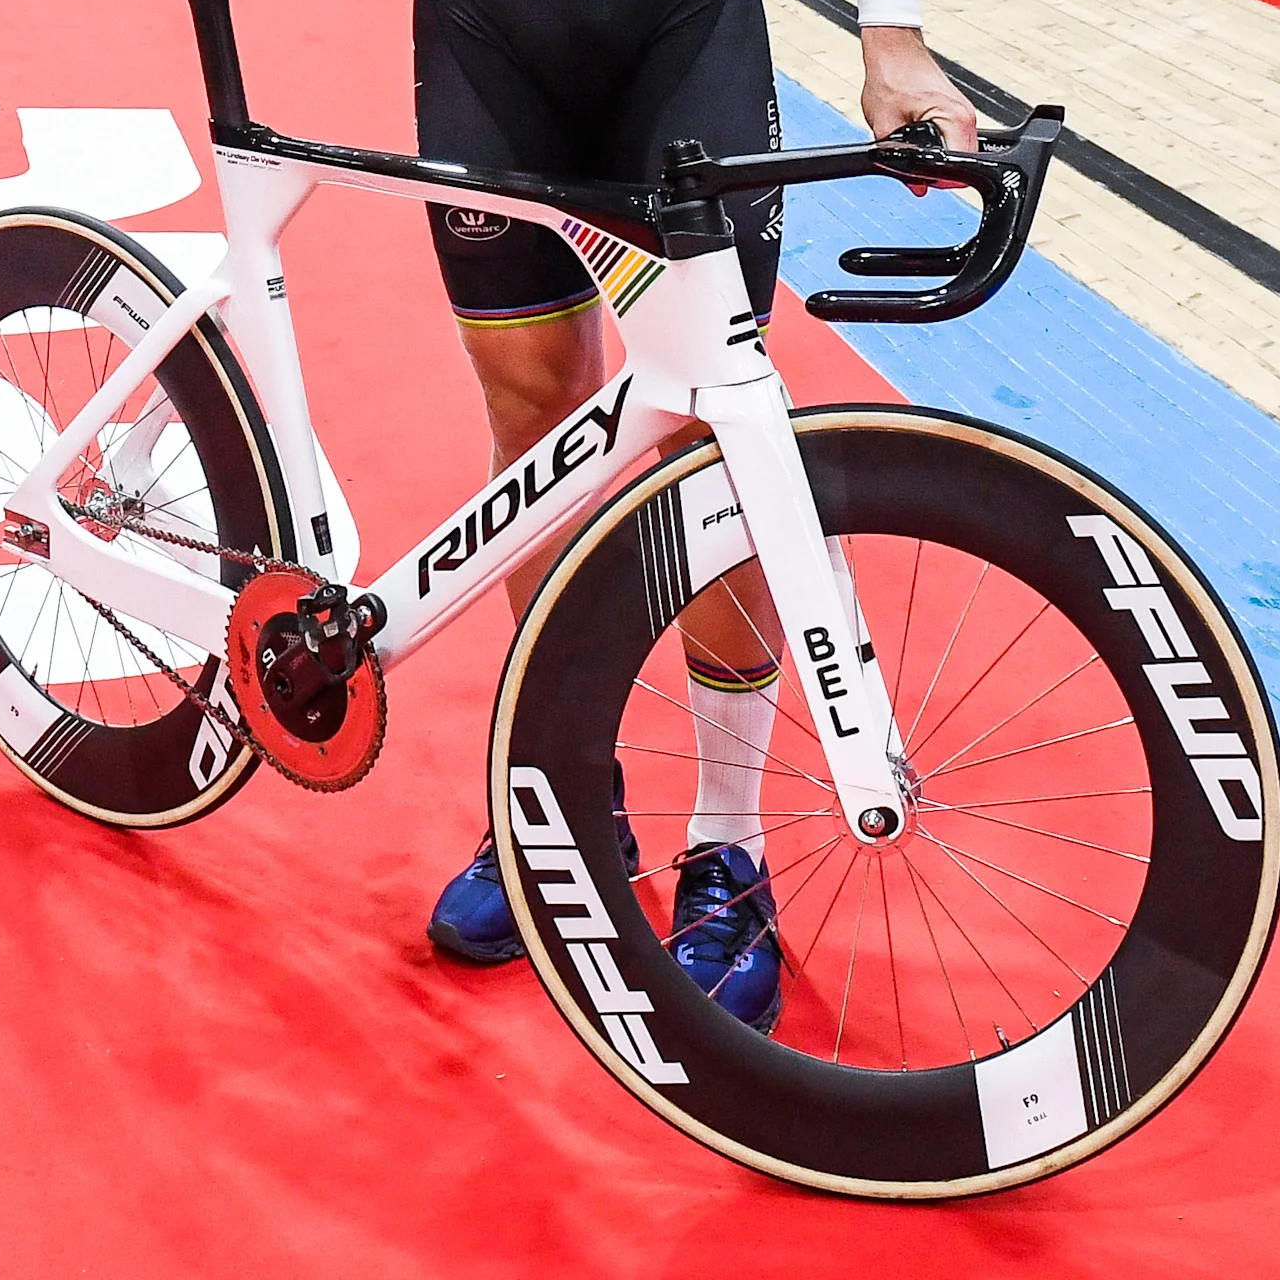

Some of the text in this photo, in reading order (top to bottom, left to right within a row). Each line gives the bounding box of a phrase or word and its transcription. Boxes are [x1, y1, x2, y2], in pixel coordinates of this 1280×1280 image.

[454, 223, 501, 234] vermarc
[112, 294, 151, 332] FFWD
[418, 372, 632, 599] RIDLEY
[802, 626, 860, 739] BEL
[1064, 513, 1263, 842] FFWD
[510, 765, 690, 1085] FFWD
[1022, 1093, 1040, 1109] F9
